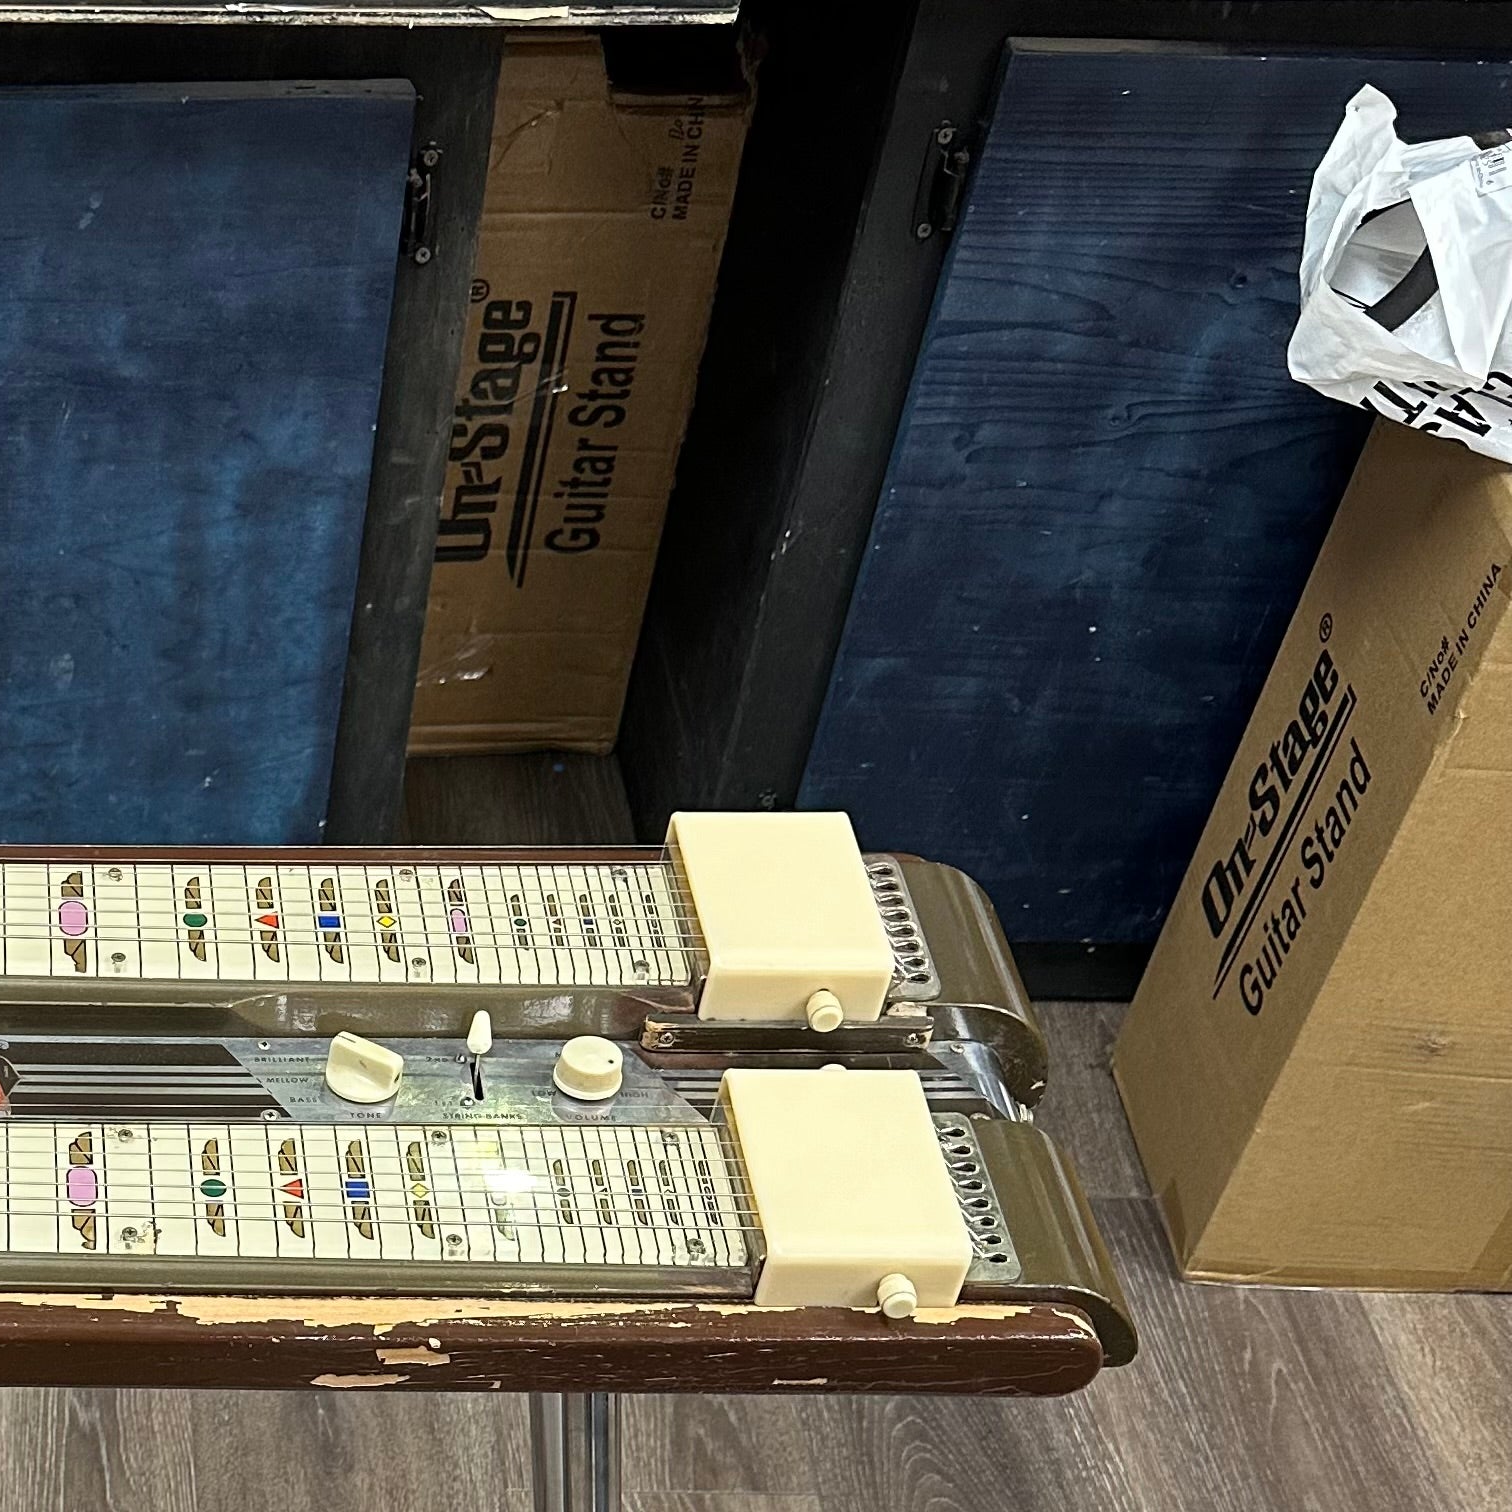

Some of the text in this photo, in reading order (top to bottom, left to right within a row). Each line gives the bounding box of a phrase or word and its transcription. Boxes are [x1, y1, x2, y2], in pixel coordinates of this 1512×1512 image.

[681, 144, 700, 162] IN
[672, 167, 696, 220] MADE
[544, 313, 645, 555] Guitar Stand
[1427, 563, 1502, 716] MADE IN CHINA
[1239, 737, 1373, 1017] Guitar Stand
[254, 1056, 310, 1064] BRILLIANT
[266, 1077, 310, 1085] MELLOW
[532, 1089, 557, 1097] LOW
[485, 1112, 523, 1120] BANKS
